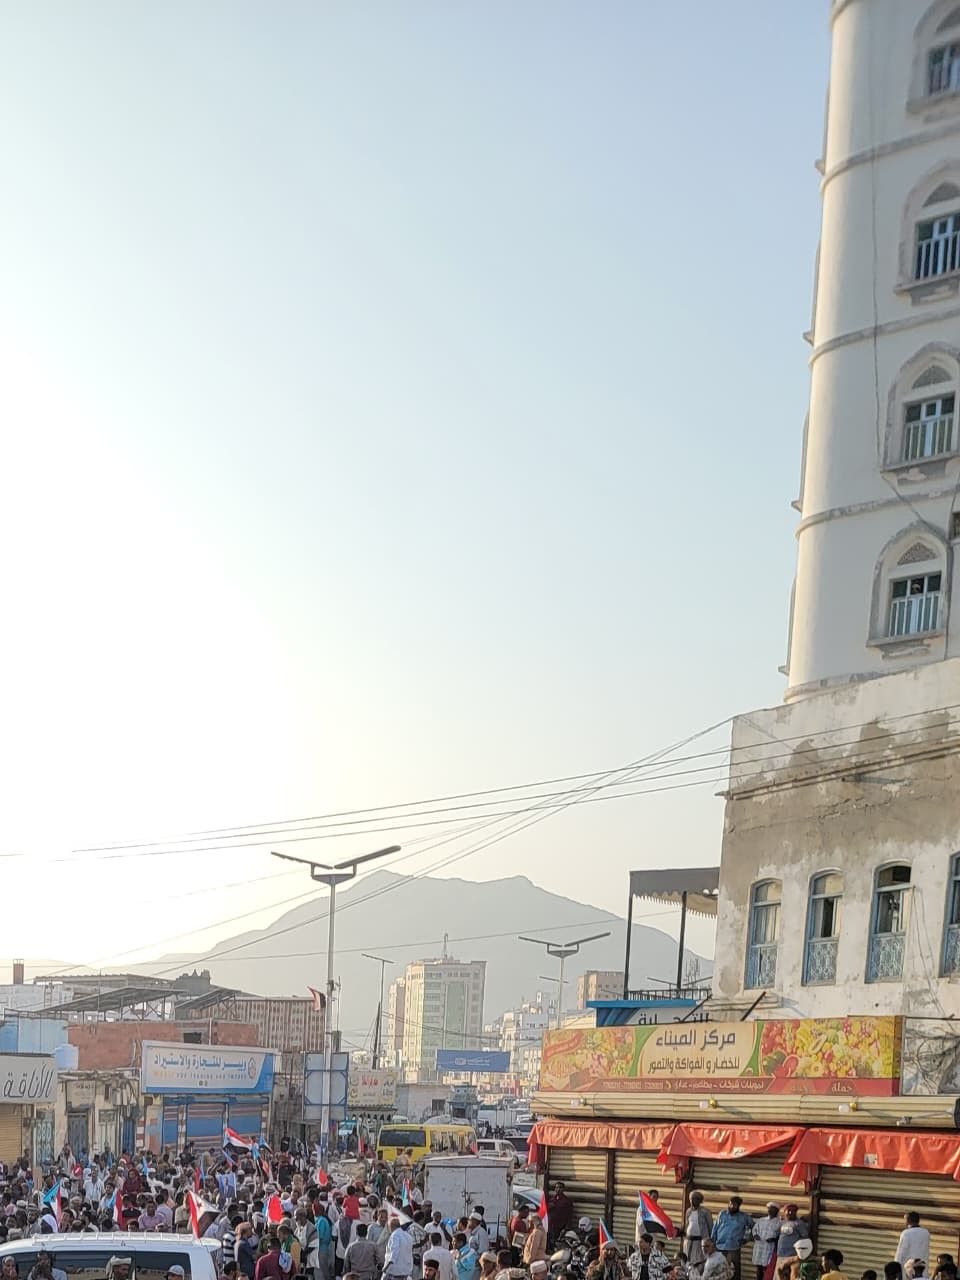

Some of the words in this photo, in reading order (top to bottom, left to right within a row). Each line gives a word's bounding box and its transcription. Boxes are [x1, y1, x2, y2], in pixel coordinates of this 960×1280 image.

[656, 1029, 697, 1051] الميناء
[701, 1029, 736, 1051] مركز
[193, 1054, 222, 1070] للتجارة
[648, 1057, 674, 1074] والتمور
[712, 1056, 740, 1074] للخضار
[3, 1062, 53, 1098] الأناقة
[831, 1082, 852, 1093] جملة
